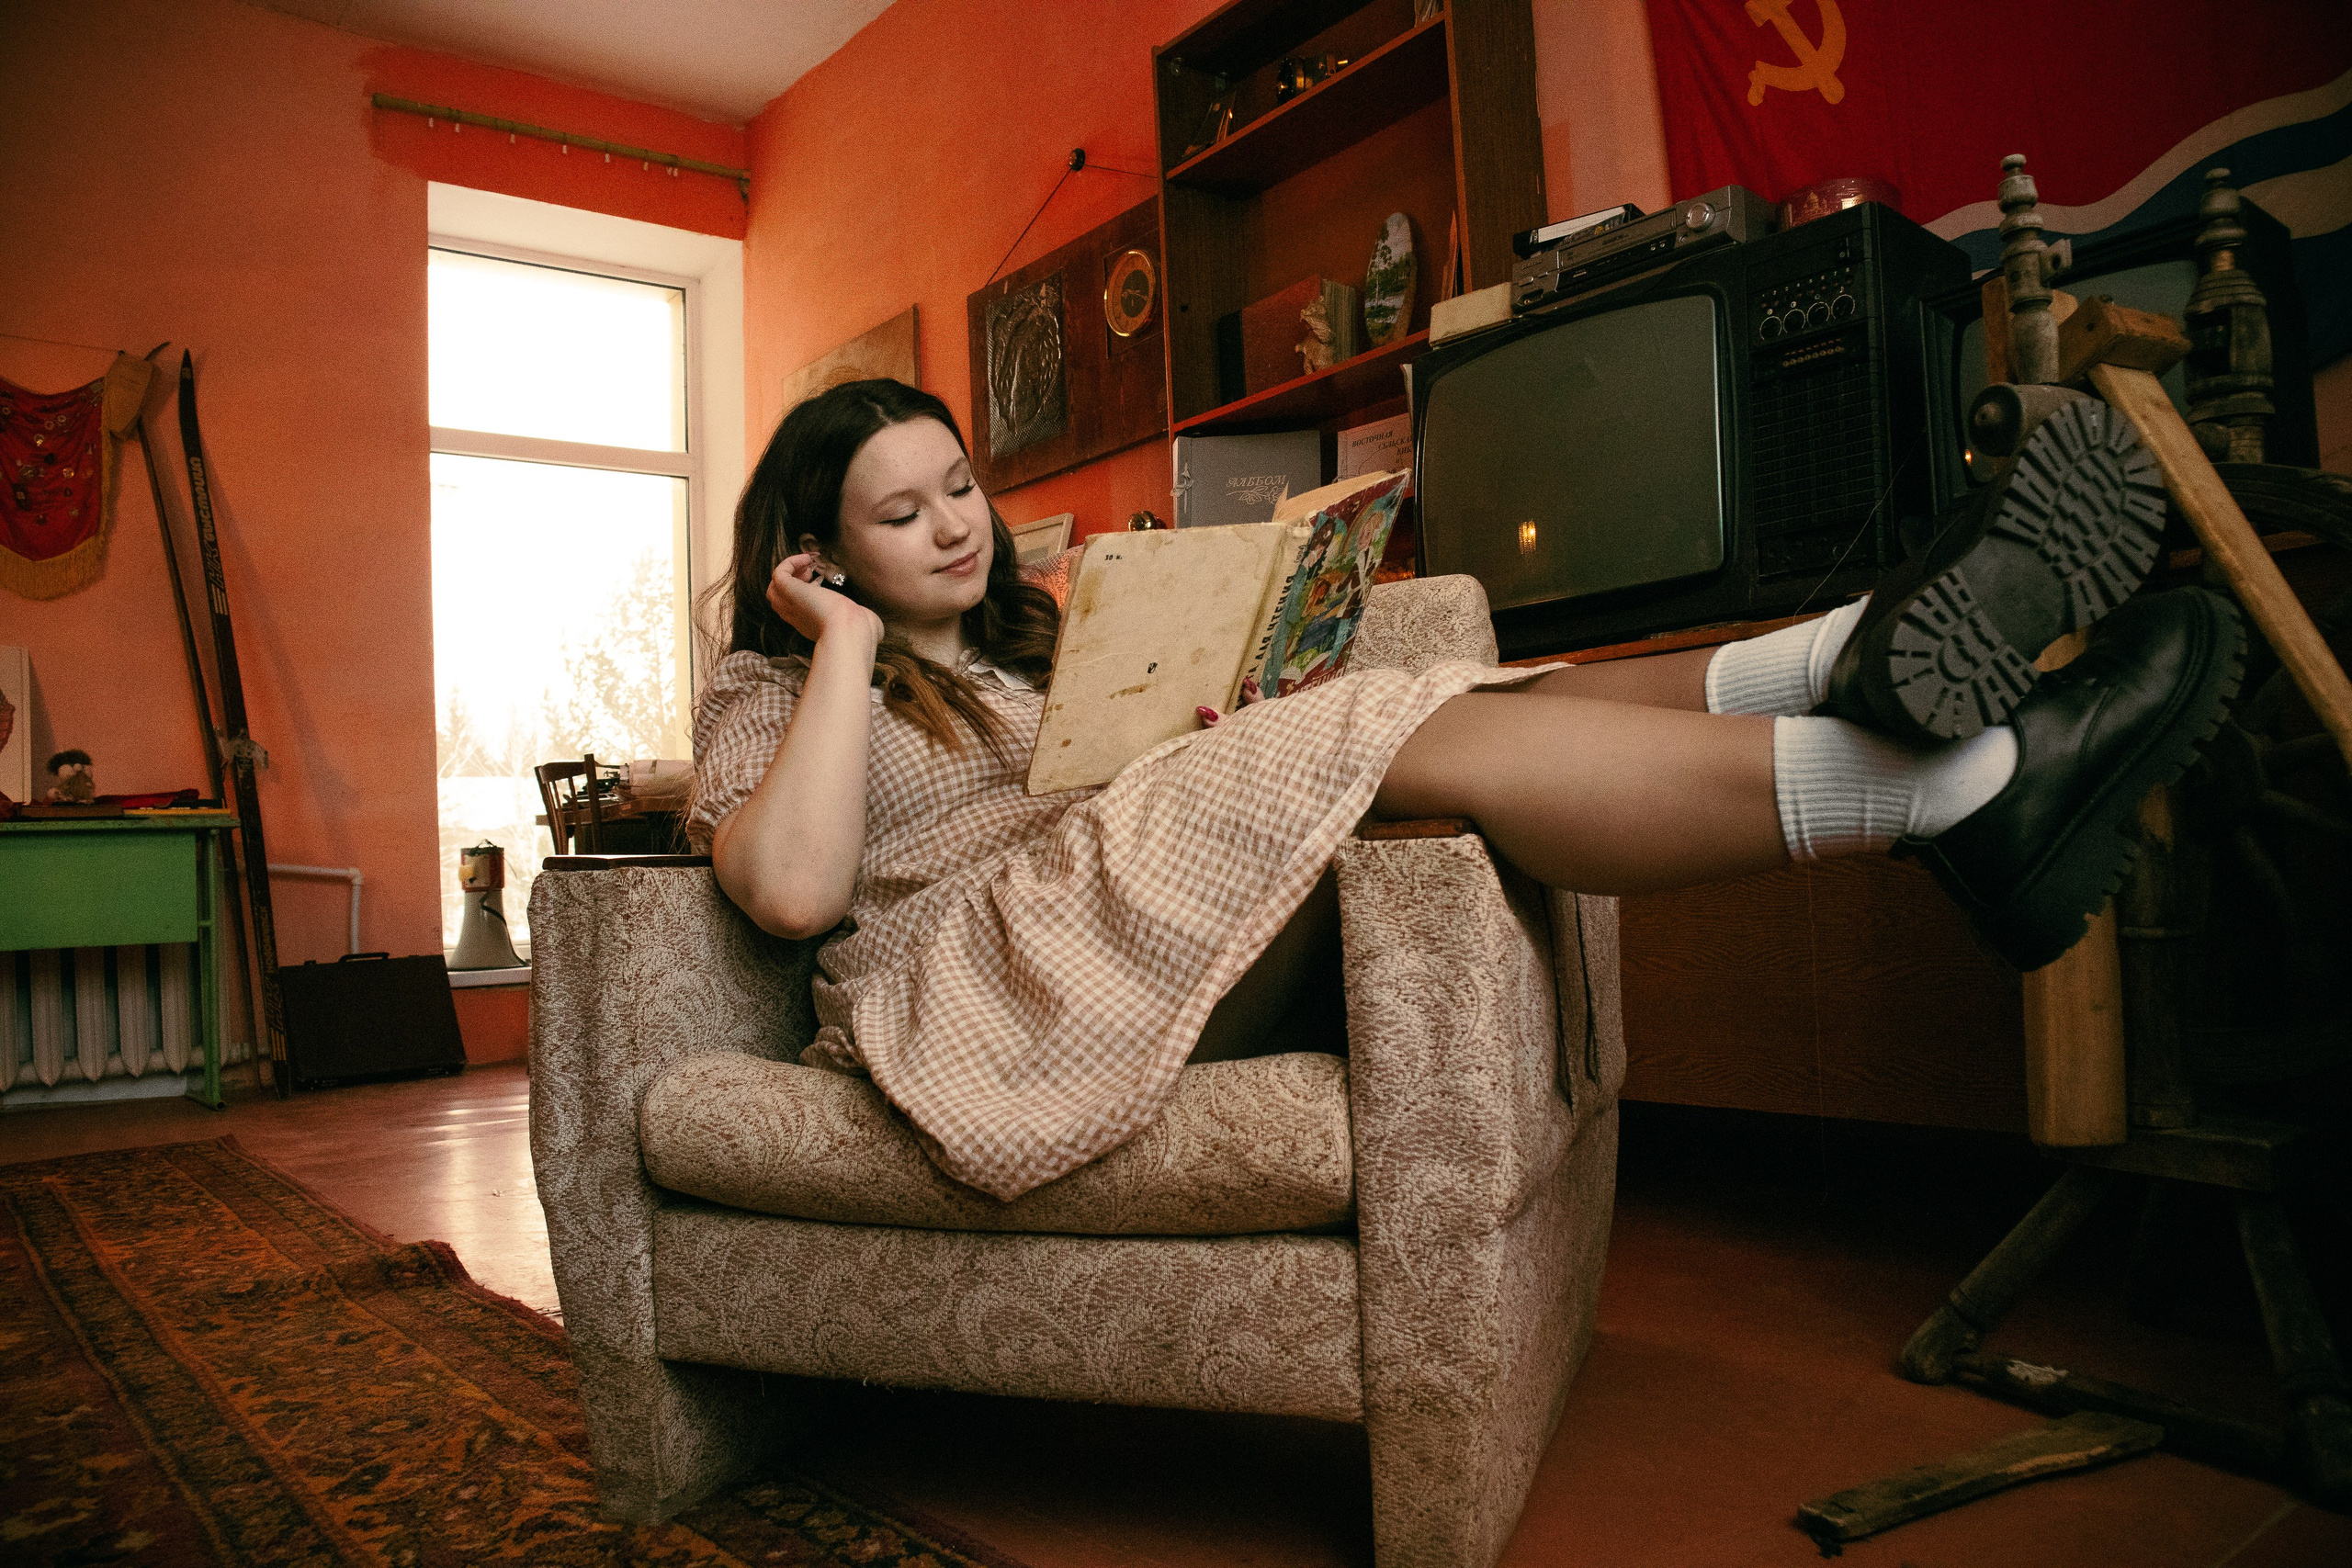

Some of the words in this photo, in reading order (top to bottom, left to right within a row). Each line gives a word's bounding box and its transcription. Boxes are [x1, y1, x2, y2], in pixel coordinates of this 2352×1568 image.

[1351, 430, 1394, 447] ВОСТОЧНАЯ
[1378, 435, 1412, 450] СЕЛЬСКА
[1226, 474, 1287, 488] АЛЬБОМ
[1267, 575, 1296, 631] ЧТЕНИЯ
